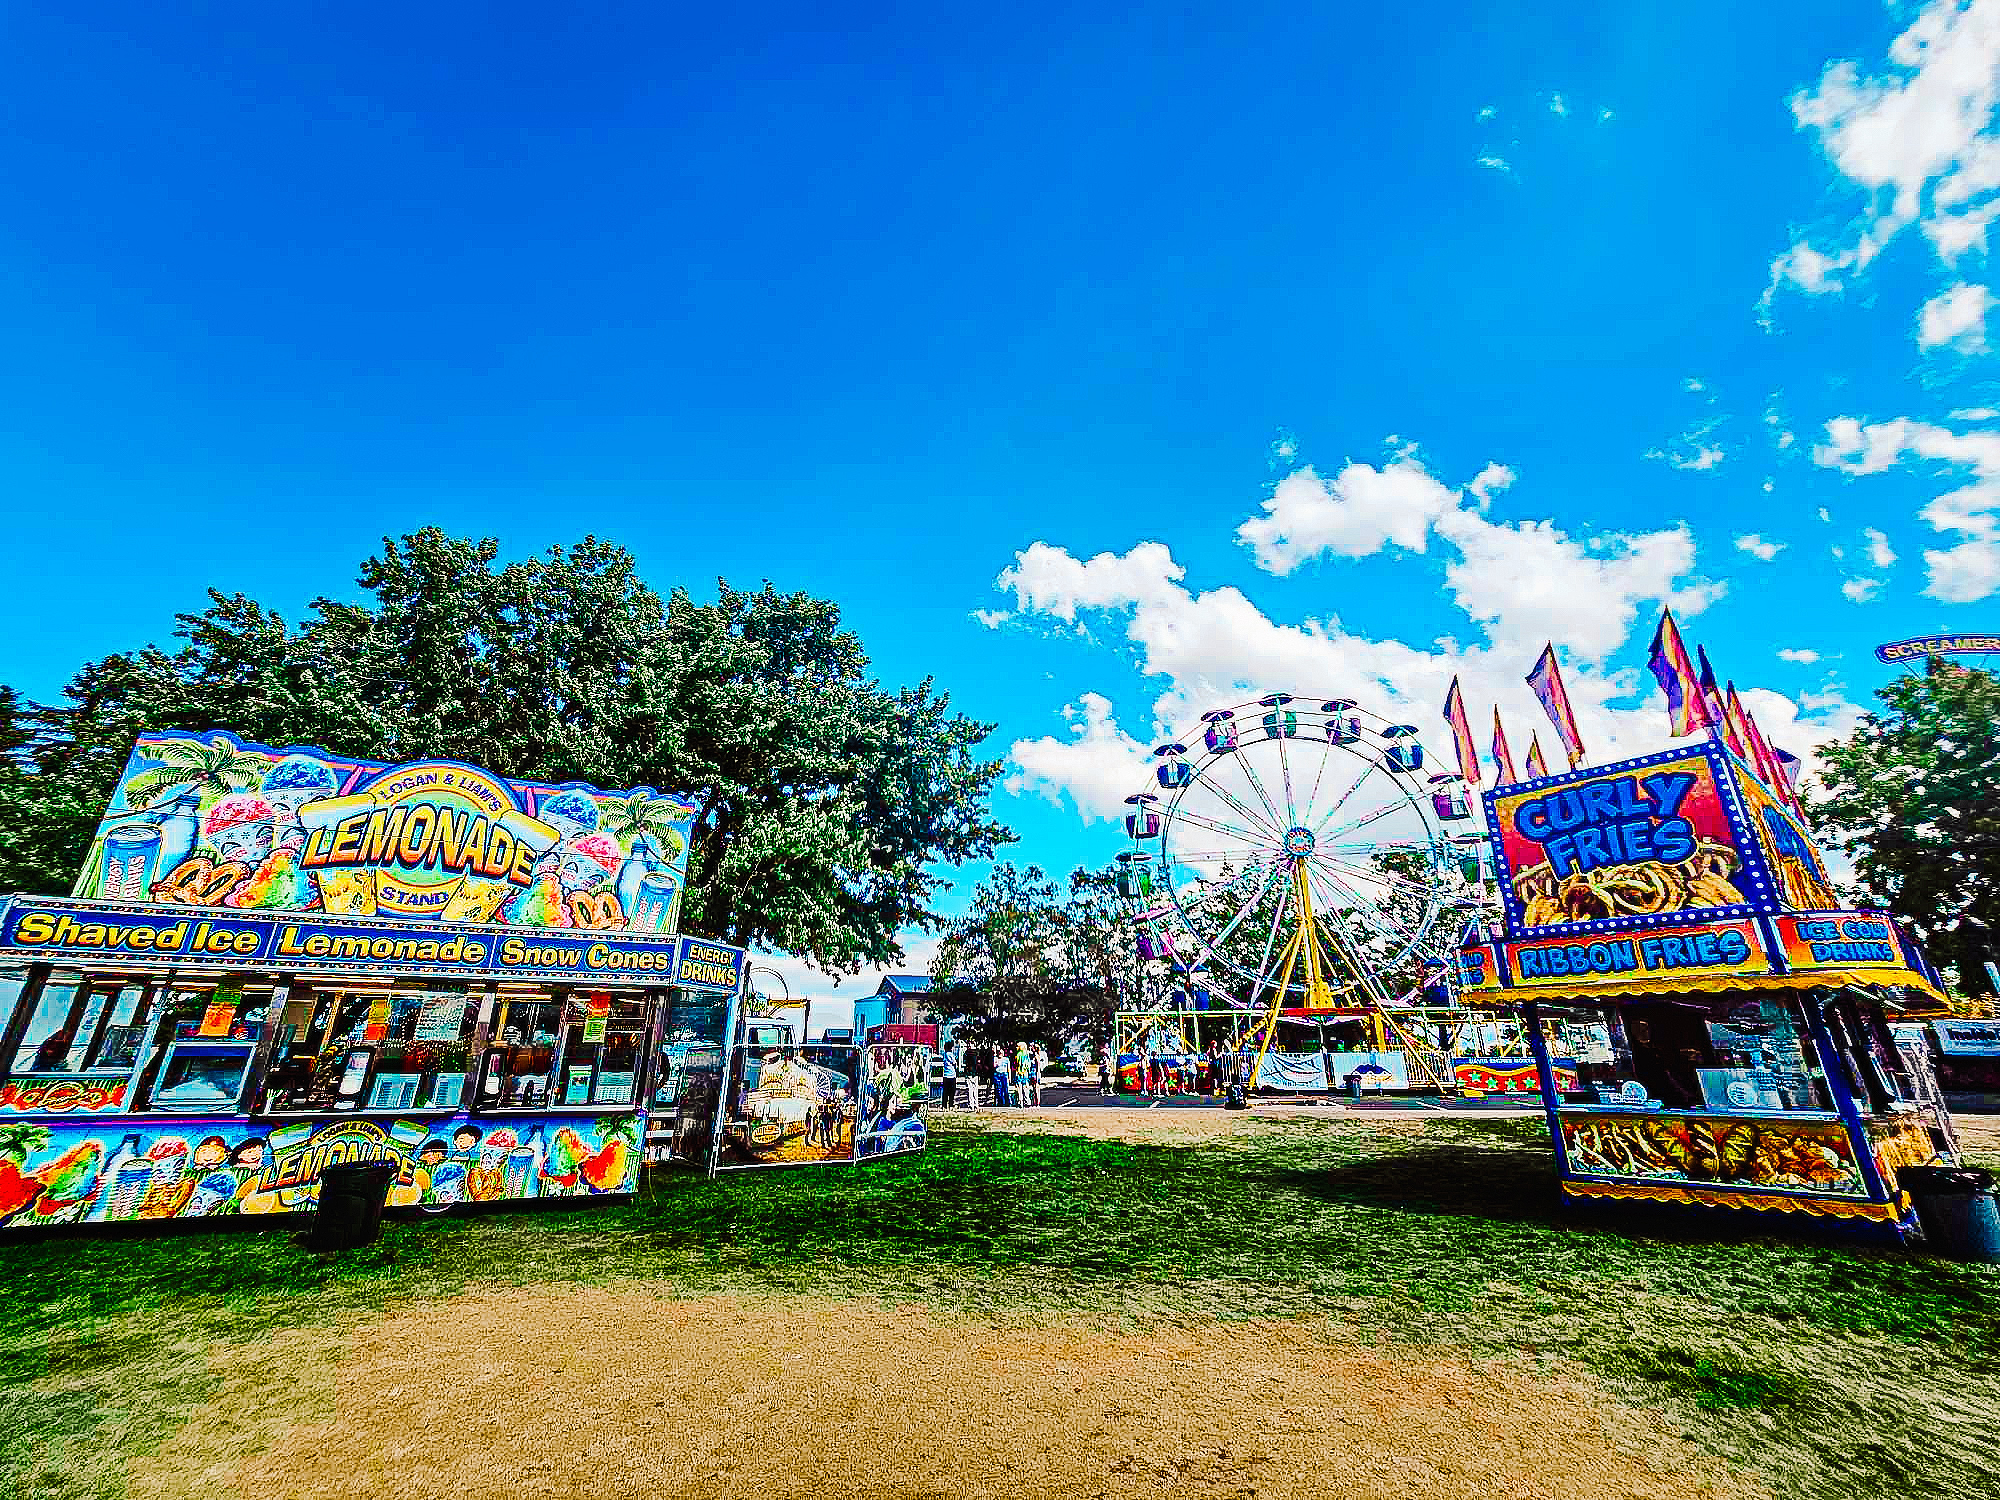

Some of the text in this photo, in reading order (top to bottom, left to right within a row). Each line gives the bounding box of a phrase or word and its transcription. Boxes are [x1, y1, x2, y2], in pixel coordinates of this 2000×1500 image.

[379, 773, 502, 812] LOGAN & LIAM'S
[1514, 773, 1697, 841] CURLY
[300, 803, 537, 888] LEMONADE
[1544, 816, 1699, 881] FRIES
[380, 886, 449, 906] STAND
[16, 912, 260, 954] Shaved Ice
[279, 926, 487, 963] Lemonade
[1797, 921, 1841, 940] ICE
[502, 938, 669, 970] Snow Cones
[690, 944, 735, 966] ENERGY
[1517, 931, 1750, 978] RIBBON FRIES
[1811, 942, 1894, 961] DRINKS
[681, 960, 736, 986] DRINKS
